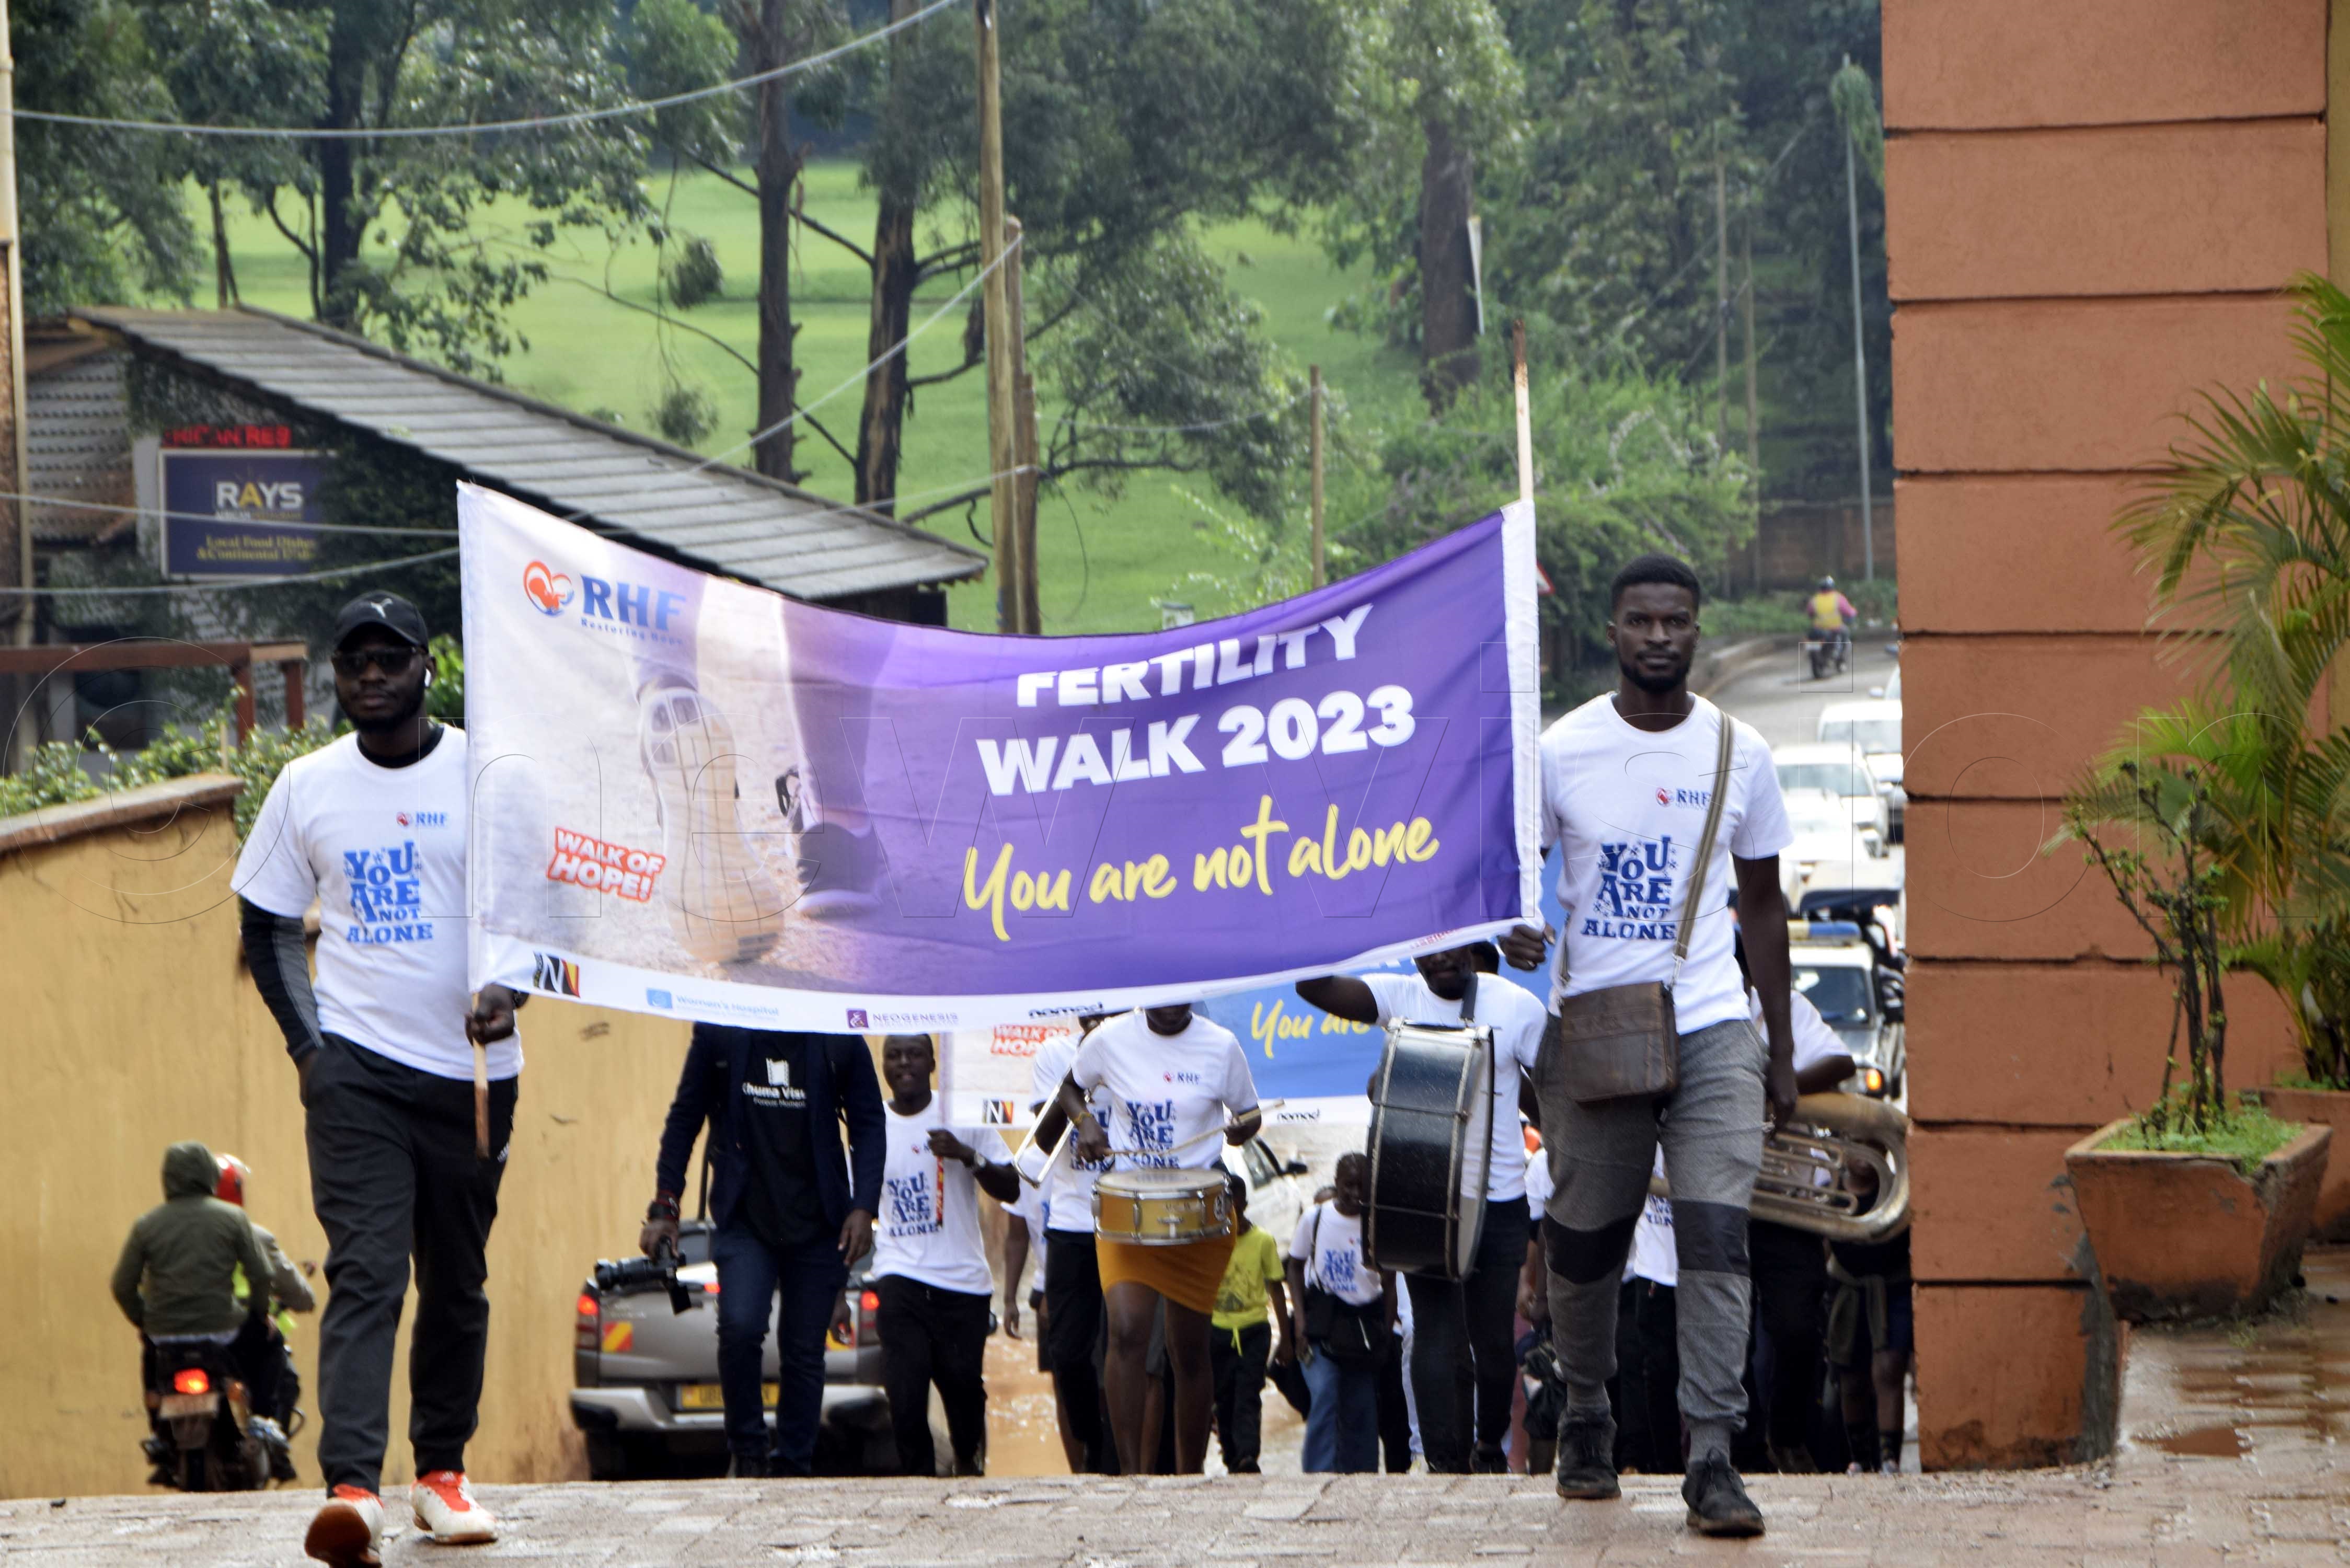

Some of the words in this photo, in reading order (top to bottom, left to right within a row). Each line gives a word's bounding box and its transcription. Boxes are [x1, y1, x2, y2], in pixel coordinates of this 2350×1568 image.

[216, 481, 304, 509] RAYS
[581, 573, 686, 630] RHF
[581, 617, 645, 640] Restoring
[1017, 604, 1374, 708] FERTILITY
[976, 713, 1205, 797] WALK
[1218, 684, 1416, 768] 2023
[343, 840, 415, 886] YOU
[556, 828, 622, 866] WALK
[626, 850, 663, 875] OF
[963, 843, 1070, 942] You
[1089, 854, 1178, 902] are
[1193, 794, 1289, 896] not
[1288, 803, 1440, 881] alone
[1600, 835, 1672, 881] YOU
[549, 852, 654, 900] HOPE!
[1598, 876, 1674, 918] ARE
[350, 878, 420, 923] ARE
[378, 907, 421, 922] NOT
[1626, 903, 1671, 918] NOT
[346, 922, 434, 943] ALONE
[1581, 919, 1678, 940] ALONE
[872, 1012, 959, 1022] NEOGENESIS
[1251, 998, 1314, 1059] You
[993, 1037, 1037, 1055] HOP
